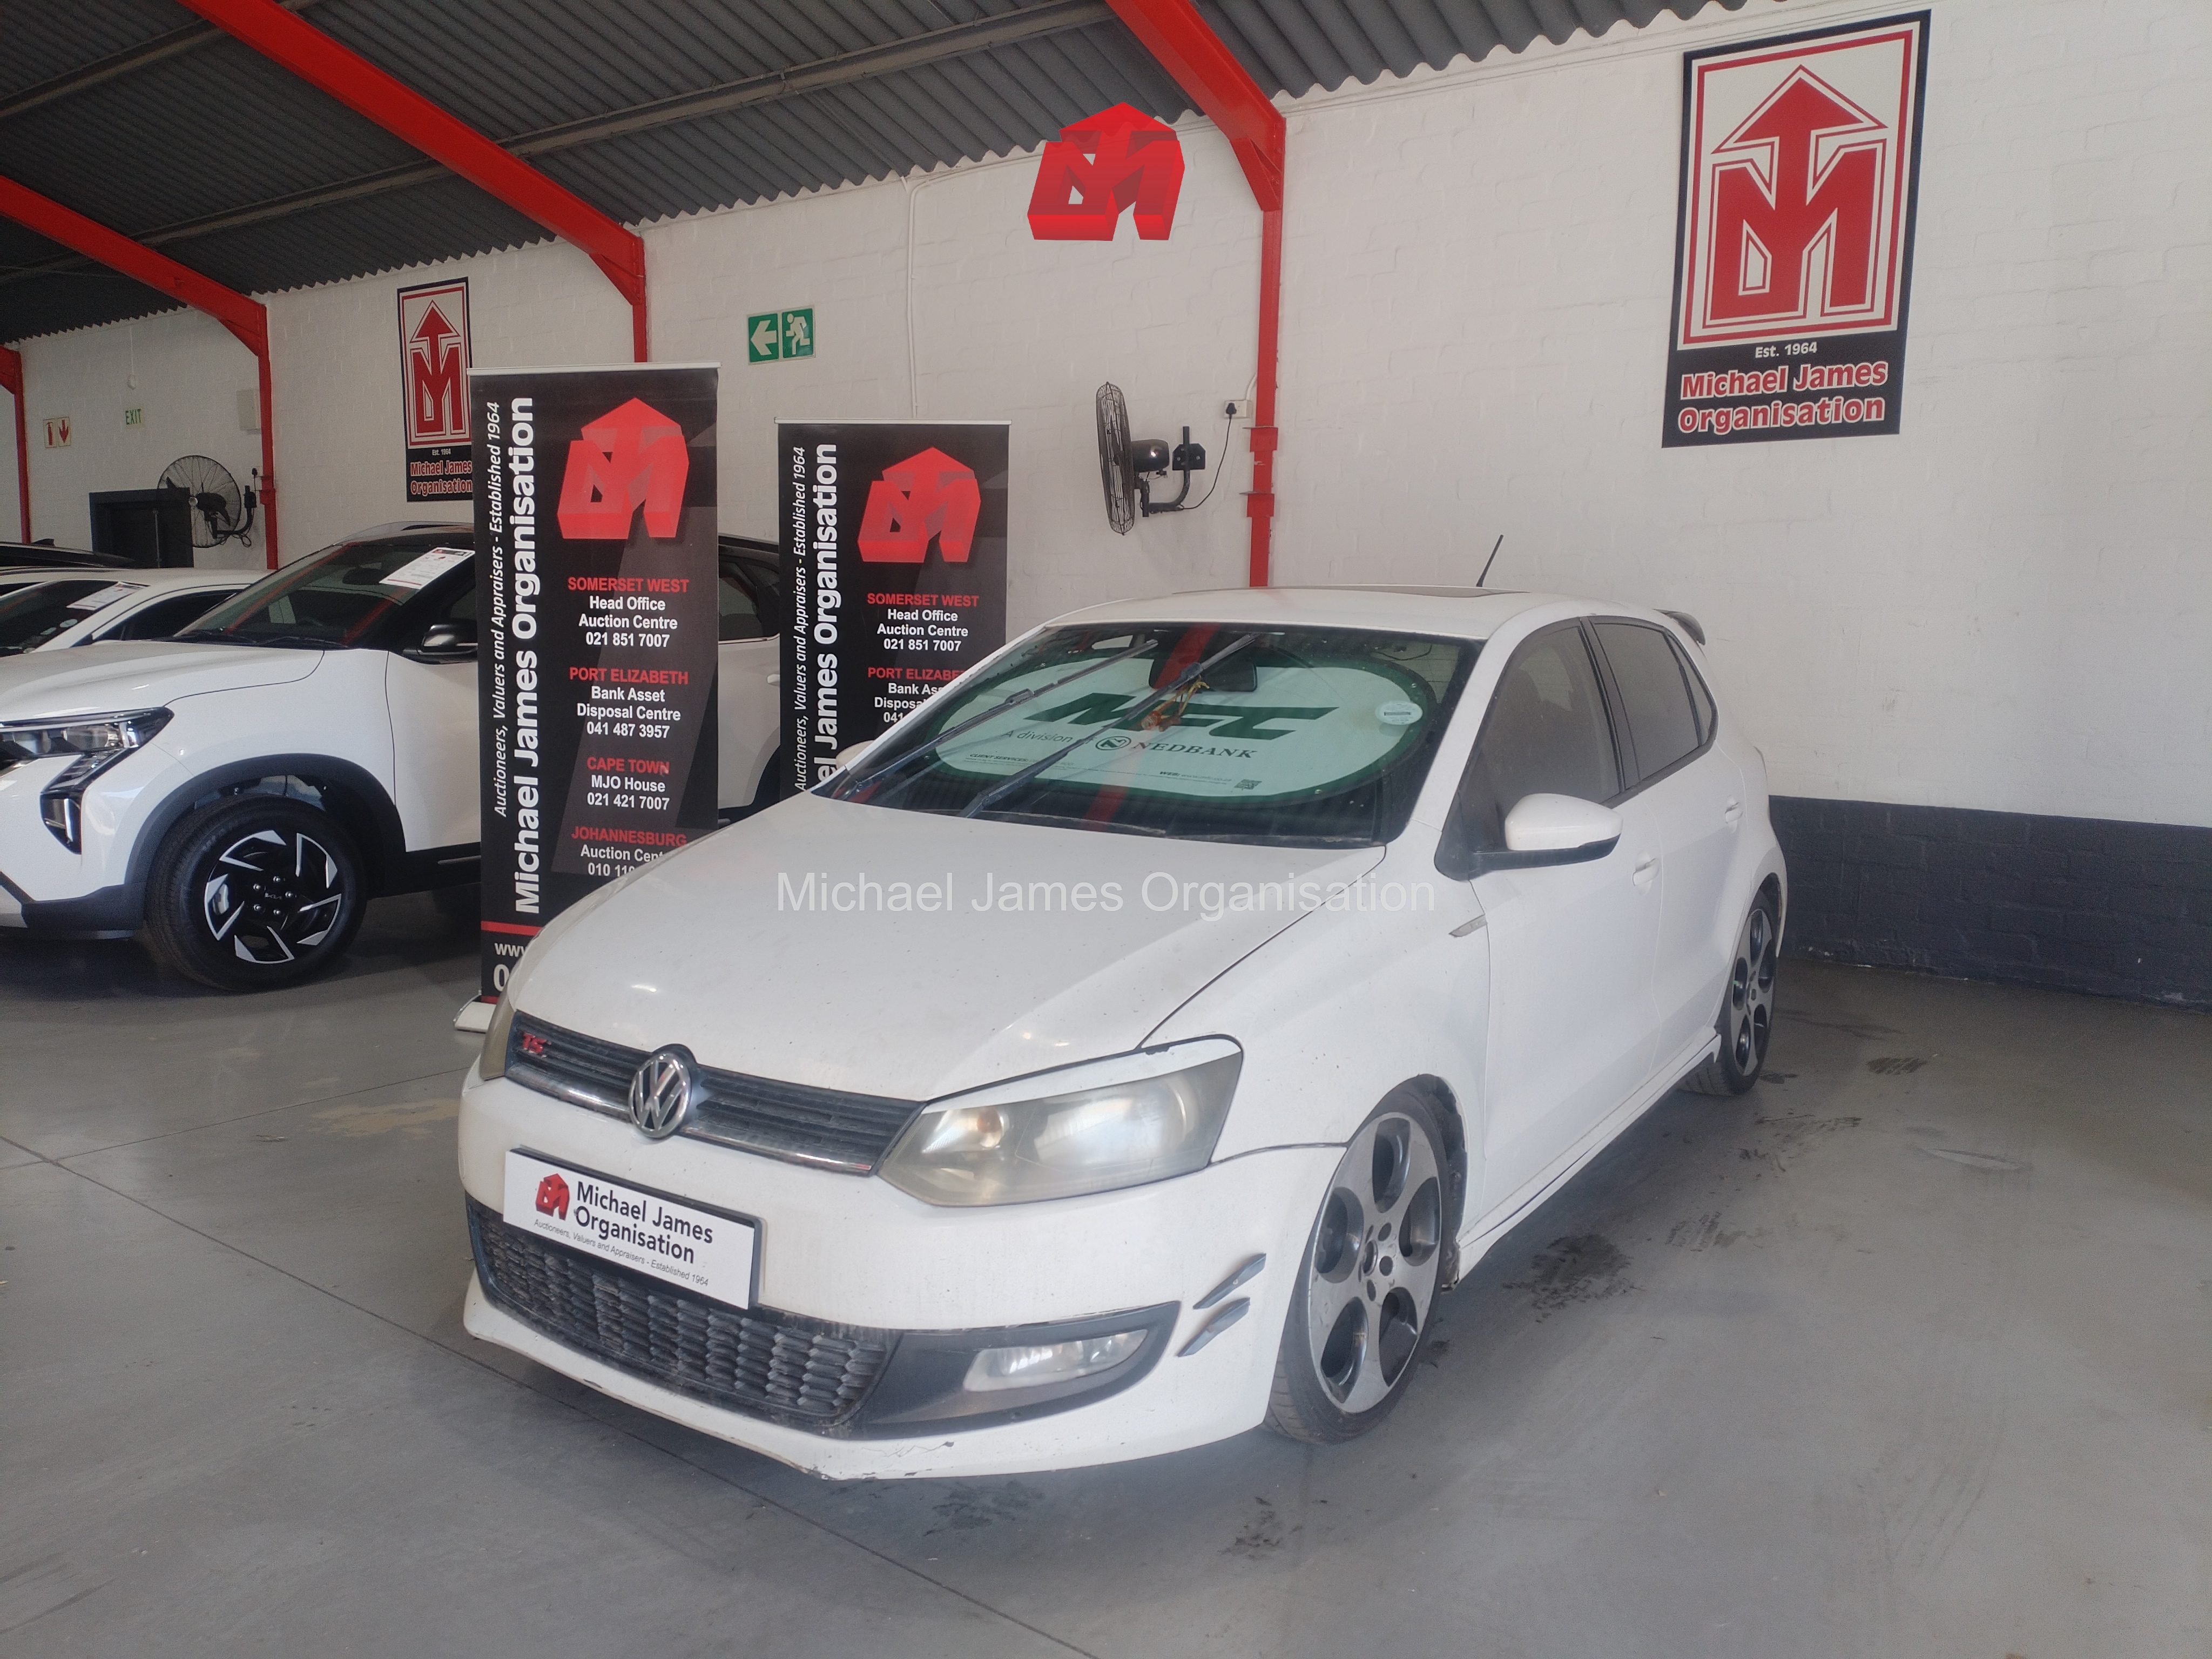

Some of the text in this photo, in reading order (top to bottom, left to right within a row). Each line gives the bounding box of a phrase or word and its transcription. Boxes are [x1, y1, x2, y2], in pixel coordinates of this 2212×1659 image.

[1755, 341, 1818, 359] Est. 1964
[1680, 360, 1889, 400] Michael James
[125, 408, 141, 425] EXIT
[487, 401, 500, 440] 1964
[1678, 395, 1886, 436] Organisation
[410, 460, 473, 476] Michael James
[793, 446, 805, 479] 1964
[410, 478, 473, 497] Organisation
[487, 444, 502, 533] Established
[792, 482, 806, 556] Established
[812, 444, 841, 645] Organisation
[489, 545, 507, 628] Appraisers
[568, 577, 690, 593] SOMERSET WEST
[589, 595, 666, 611] Head Office
[793, 567, 808, 635] Appraisers
[867, 592, 980, 607] SOMERSET WEST
[578, 613, 678, 630] Auction Centre
[887, 608, 959, 622] Head Office
[585, 631, 670, 648] 021 851 7007
[876, 623, 969, 637] Auction Centre
[490, 629, 504, 660] and
[793, 636, 806, 662] and
[883, 638, 962, 652] 021 851 7007
[508, 397, 540, 914] Michael James Organisation
[569, 666, 689, 685] PORT ELIZABETH
[867, 666, 903, 679] PORT
[492, 663, 505, 718] Valuers
[591, 685, 665, 702] Bank Asset
[793, 664, 807, 710] Valuers
[888, 683, 919, 695] Bank
[814, 653, 838, 750] James
[577, 703, 681, 721] Disposal Centre
[883, 712, 903, 723] 041
[586, 721, 670, 738] 041 487 3957
[1017, 731, 1074, 743] division
[794, 716, 809, 791] Auctioneers,
[1131, 742, 1258, 759] NEDBANK
[493, 725, 508, 818] Auctioneers,
[586, 757, 670, 775] CAPE TOWN
[591, 774, 666, 793] MJO House
[586, 792, 670, 811] 021 421 7007
[571, 826, 687, 847] JOHANNESBURG
[580, 844, 631, 861] Auction
[588, 862, 610, 876] 010
[577, 1181, 713, 1244] Michael James
[576, 1205, 694, 1264] Organisation
[534, 1219, 571, 1239] Auctioneers,
[573, 1232, 596, 1247] Valuers
[597, 1242, 609, 1252] and
[610, 1245, 645, 1264] Appraisers
[651, 1259, 690, 1280] Established
[692, 1274, 709, 1286] 1964
